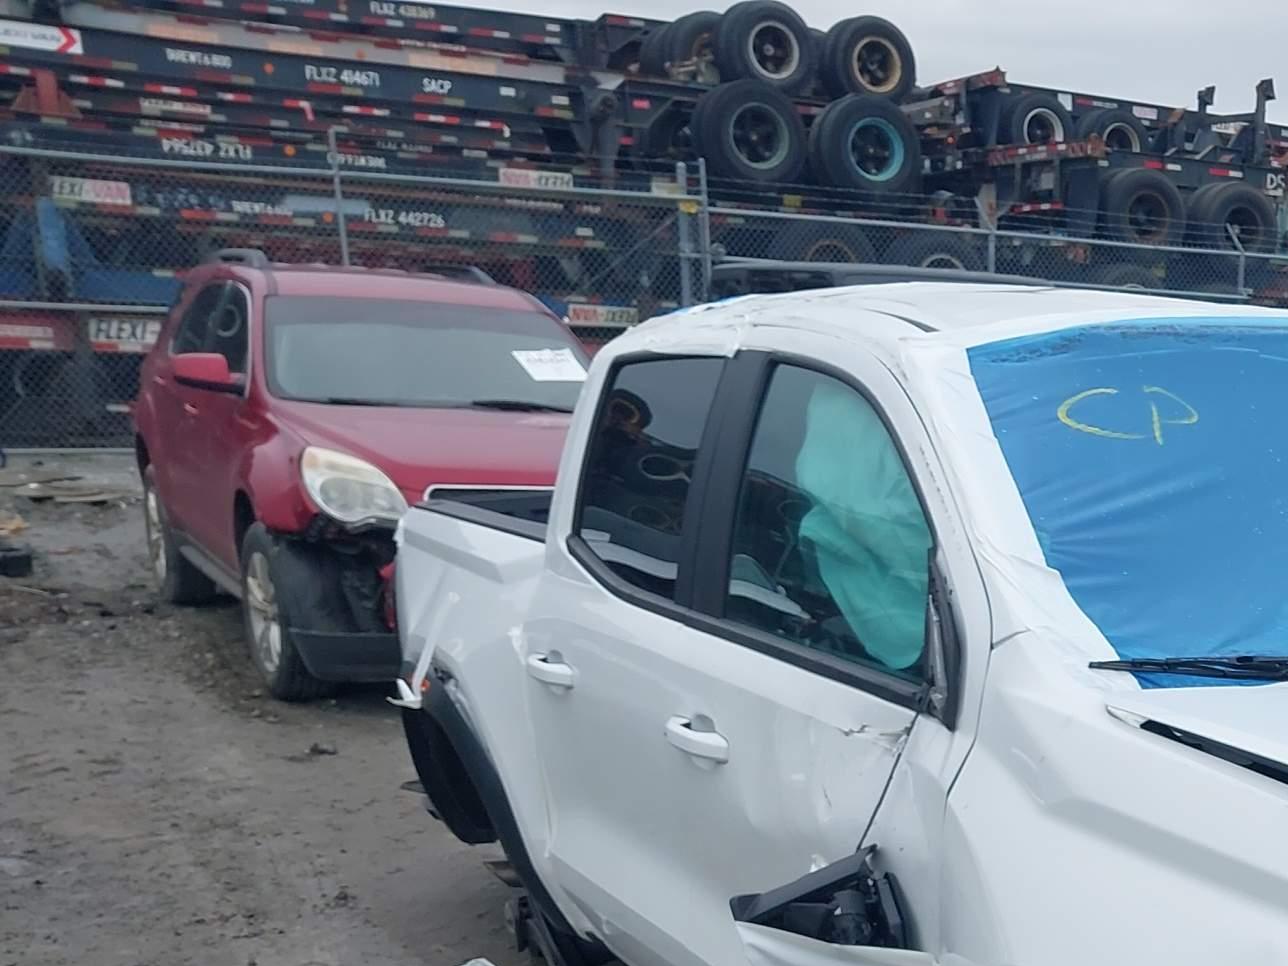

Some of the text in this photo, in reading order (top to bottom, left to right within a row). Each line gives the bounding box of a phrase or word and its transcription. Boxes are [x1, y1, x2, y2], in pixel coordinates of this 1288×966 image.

[304, 64, 338, 84] FLXZ
[422, 77, 452, 94] SACP
[364, 208, 395, 224] FLXZ
